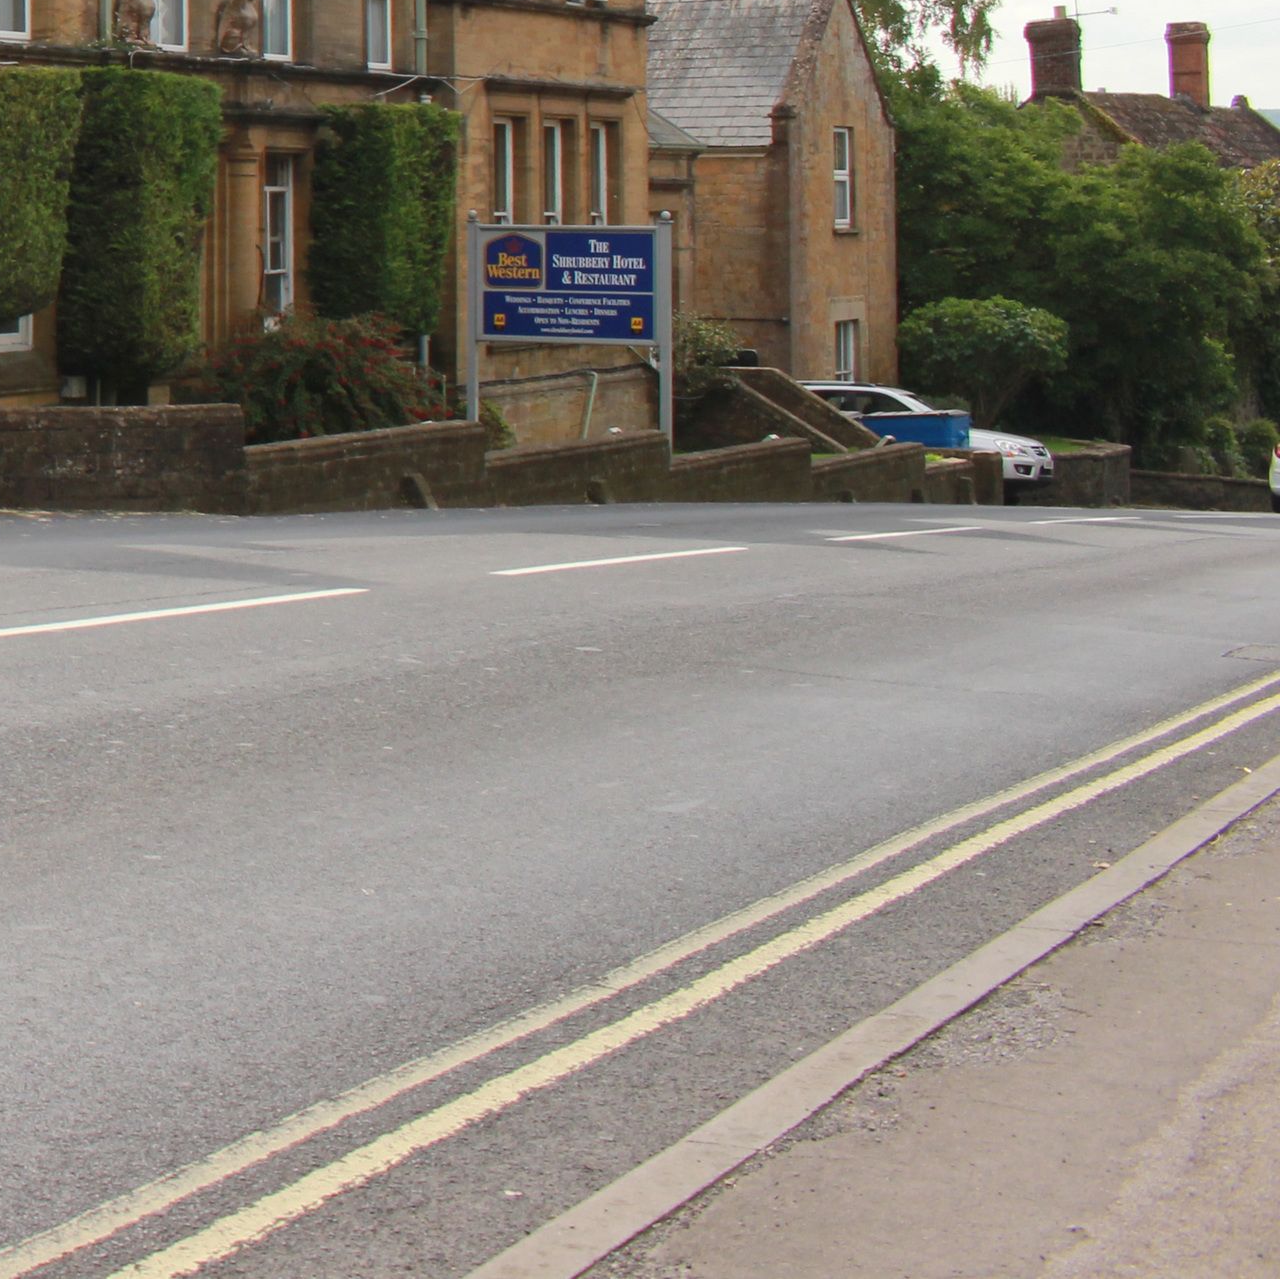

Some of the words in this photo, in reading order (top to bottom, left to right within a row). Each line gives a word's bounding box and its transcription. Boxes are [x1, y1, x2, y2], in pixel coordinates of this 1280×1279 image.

[588, 239, 609, 253] THE
[498, 252, 527, 267] Best
[552, 254, 610, 269] SHRUBBERY
[612, 255, 646, 269] HOTEL
[487, 264, 540, 279] Western
[561, 271, 572, 284] &
[574, 271, 637, 286] RESTAURANT
